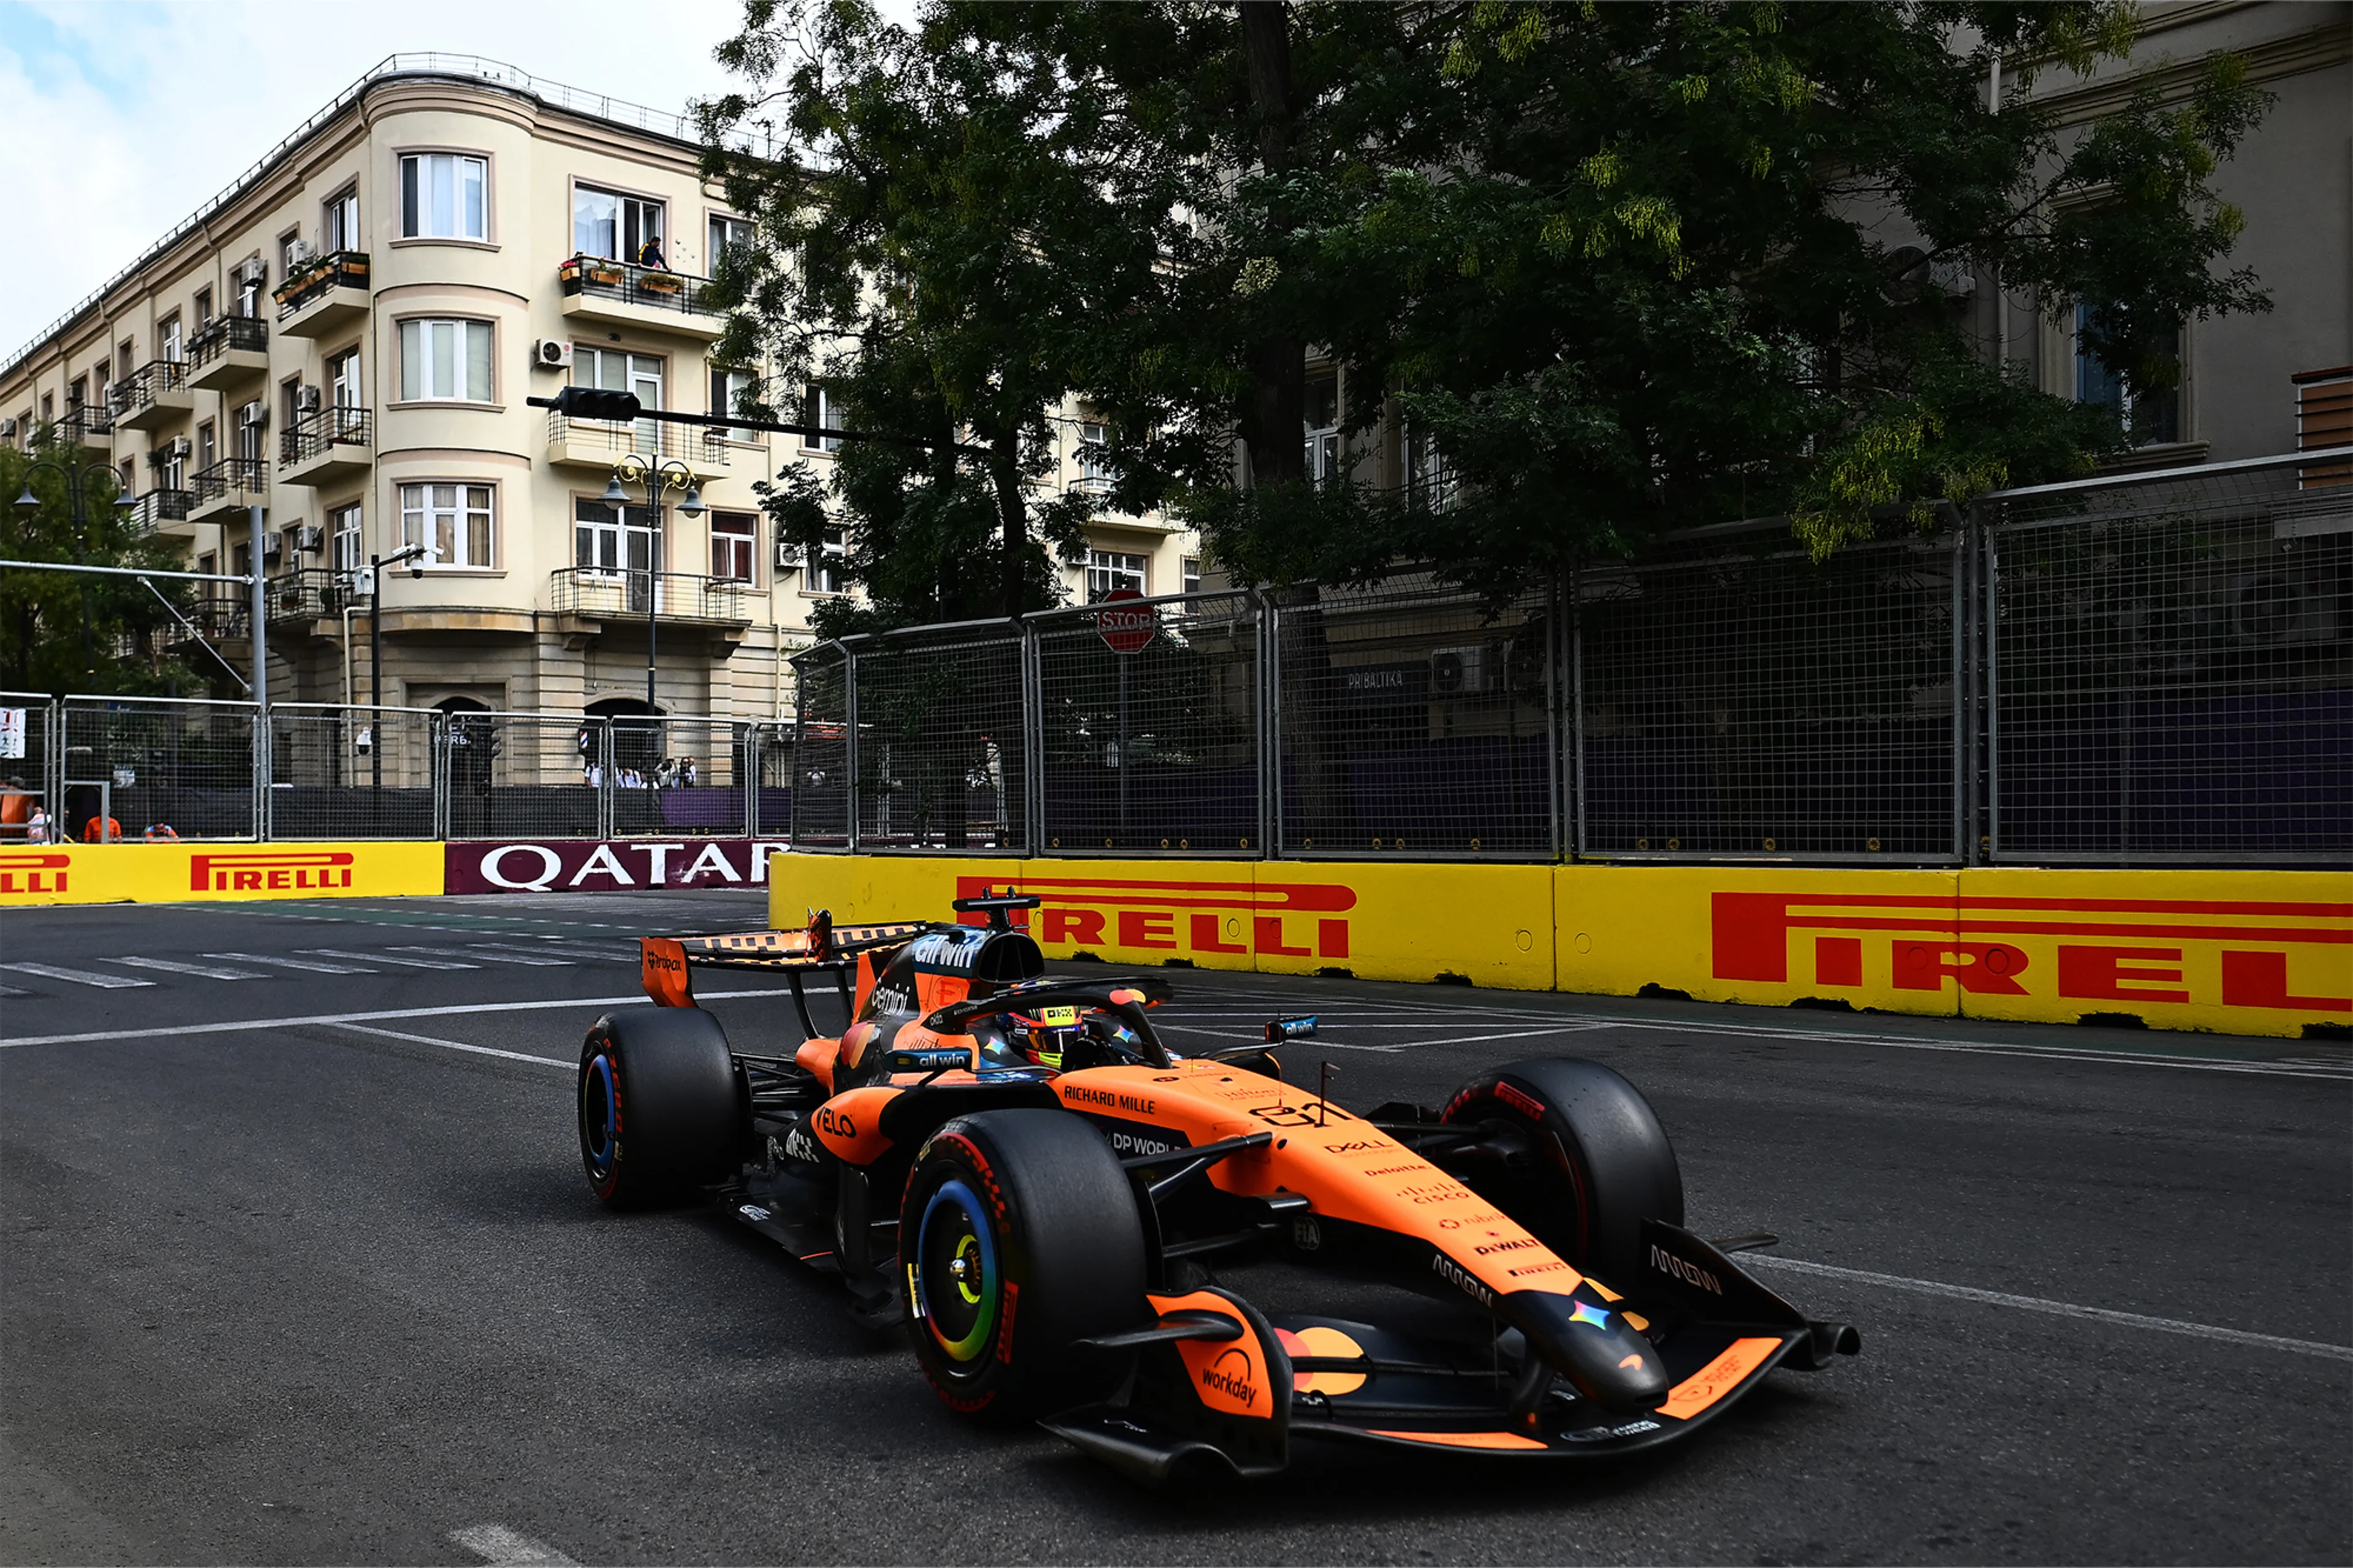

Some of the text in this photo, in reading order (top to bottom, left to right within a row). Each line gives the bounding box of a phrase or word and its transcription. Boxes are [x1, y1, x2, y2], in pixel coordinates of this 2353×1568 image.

[1102, 612, 1150, 630] STOP
[1349, 670, 1403, 689] PRIBALTIKA
[190, 852, 354, 892] PIRELLI
[957, 876, 1356, 958] PIRELLI
[915, 934, 975, 968] all win
[1711, 892, 2353, 1012] PIREL
[871, 977, 910, 1016] Gemini
[920, 1053, 965, 1067] all win
[1064, 1085, 1155, 1115] RICHARD MILLE
[817, 1106, 857, 1138] VELO
[1113, 1133, 1131, 1150] DP
[1324, 1140, 1393, 1153] DELL
[1414, 1192, 1469, 1205] CISCO
[1294, 1222, 1317, 1243] FIA
[1432, 1253, 1493, 1309] ARROW
[1651, 1243, 1723, 1296] ARROW
[1203, 1368, 1257, 1408] workday
